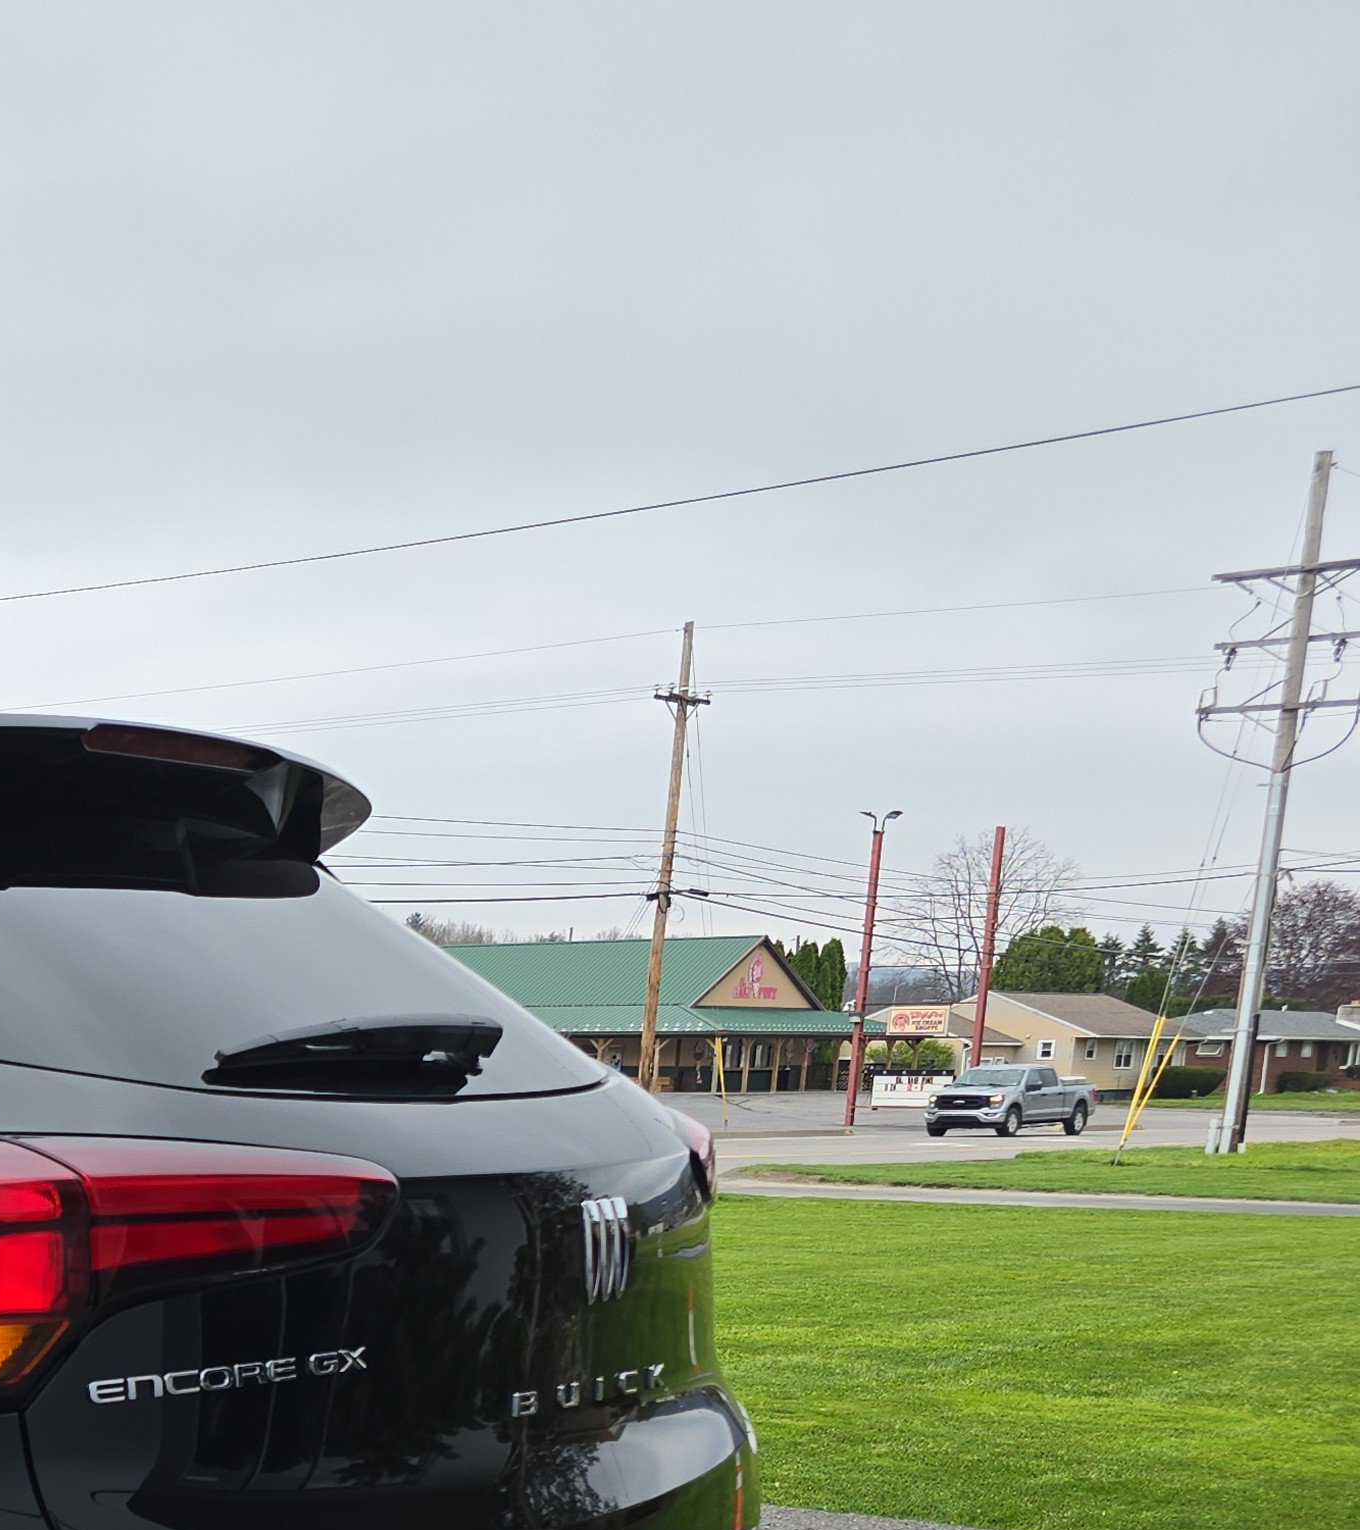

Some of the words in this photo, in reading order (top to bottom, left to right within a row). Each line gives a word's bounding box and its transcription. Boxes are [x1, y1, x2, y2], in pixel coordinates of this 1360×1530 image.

[88, 1356, 297, 1404] ENCORE
[308, 1346, 368, 1376] GX
[509, 1362, 666, 1418] BUICK
